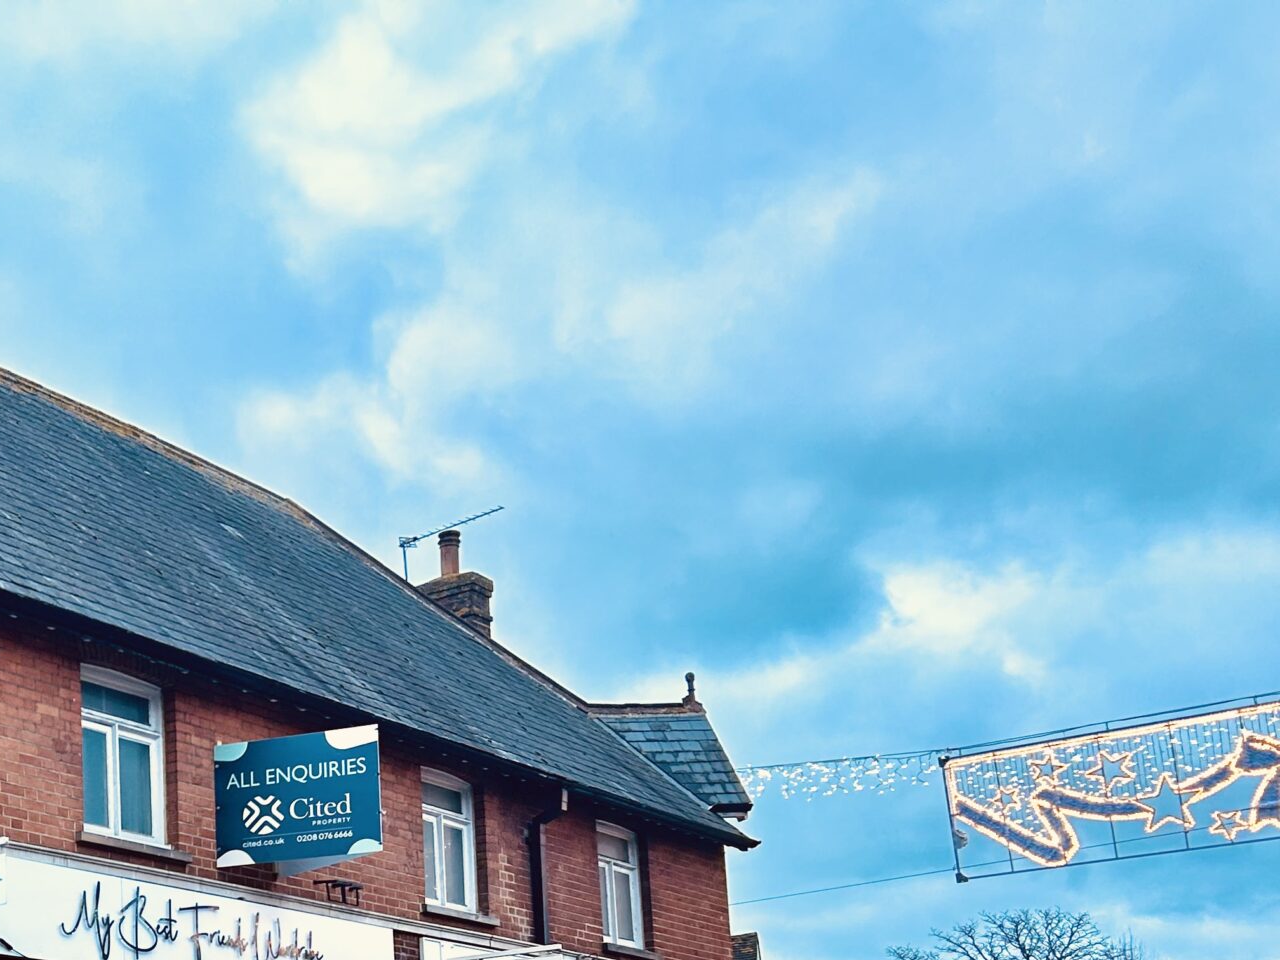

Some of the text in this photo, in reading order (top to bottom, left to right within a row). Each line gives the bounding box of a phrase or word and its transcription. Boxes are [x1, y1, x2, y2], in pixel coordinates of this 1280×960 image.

[226, 757, 367, 790] ALL ENQUIRIES
[289, 793, 352, 820] Cited
[312, 816, 351, 826] PROPERTY
[242, 837, 285, 849] cited.co.uk
[296, 830, 353, 843] 0208 076 6666
[61, 881, 114, 960] My
[118, 886, 179, 960] Best
